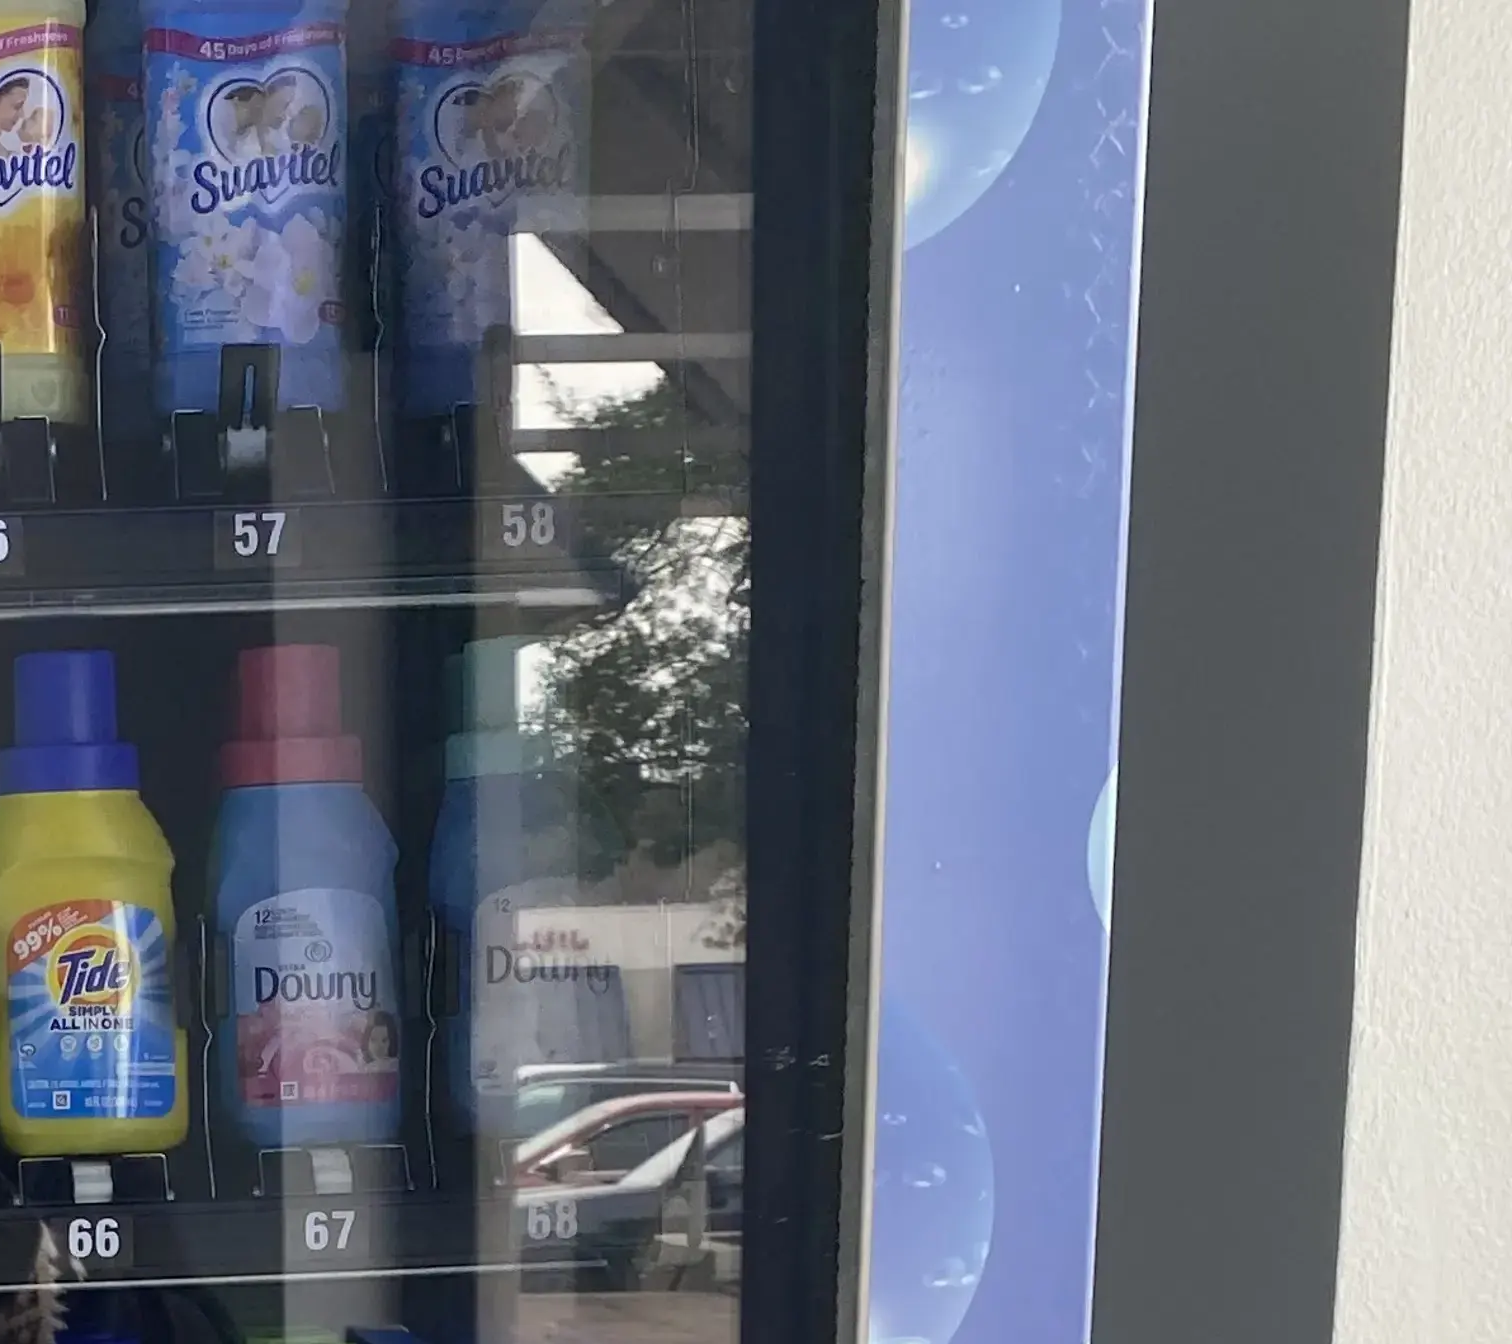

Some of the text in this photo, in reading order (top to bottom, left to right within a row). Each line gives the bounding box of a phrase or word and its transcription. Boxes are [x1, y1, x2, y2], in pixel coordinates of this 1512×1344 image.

[199, 41, 226, 60] 45
[190, 142, 339, 215] Suavitel
[232, 511, 286, 557] 57
[501, 502, 555, 547] 58
[254, 910, 272, 925] 12
[13, 920, 63, 961] 99%
[56, 948, 132, 1006] Tide
[254, 965, 377, 1011] Downy
[50, 1018, 81, 1031] ALL
[68, 1005, 117, 1017] SIMPLY
[68, 1217, 120, 1258] 66
[304, 1210, 357, 1251] 67
